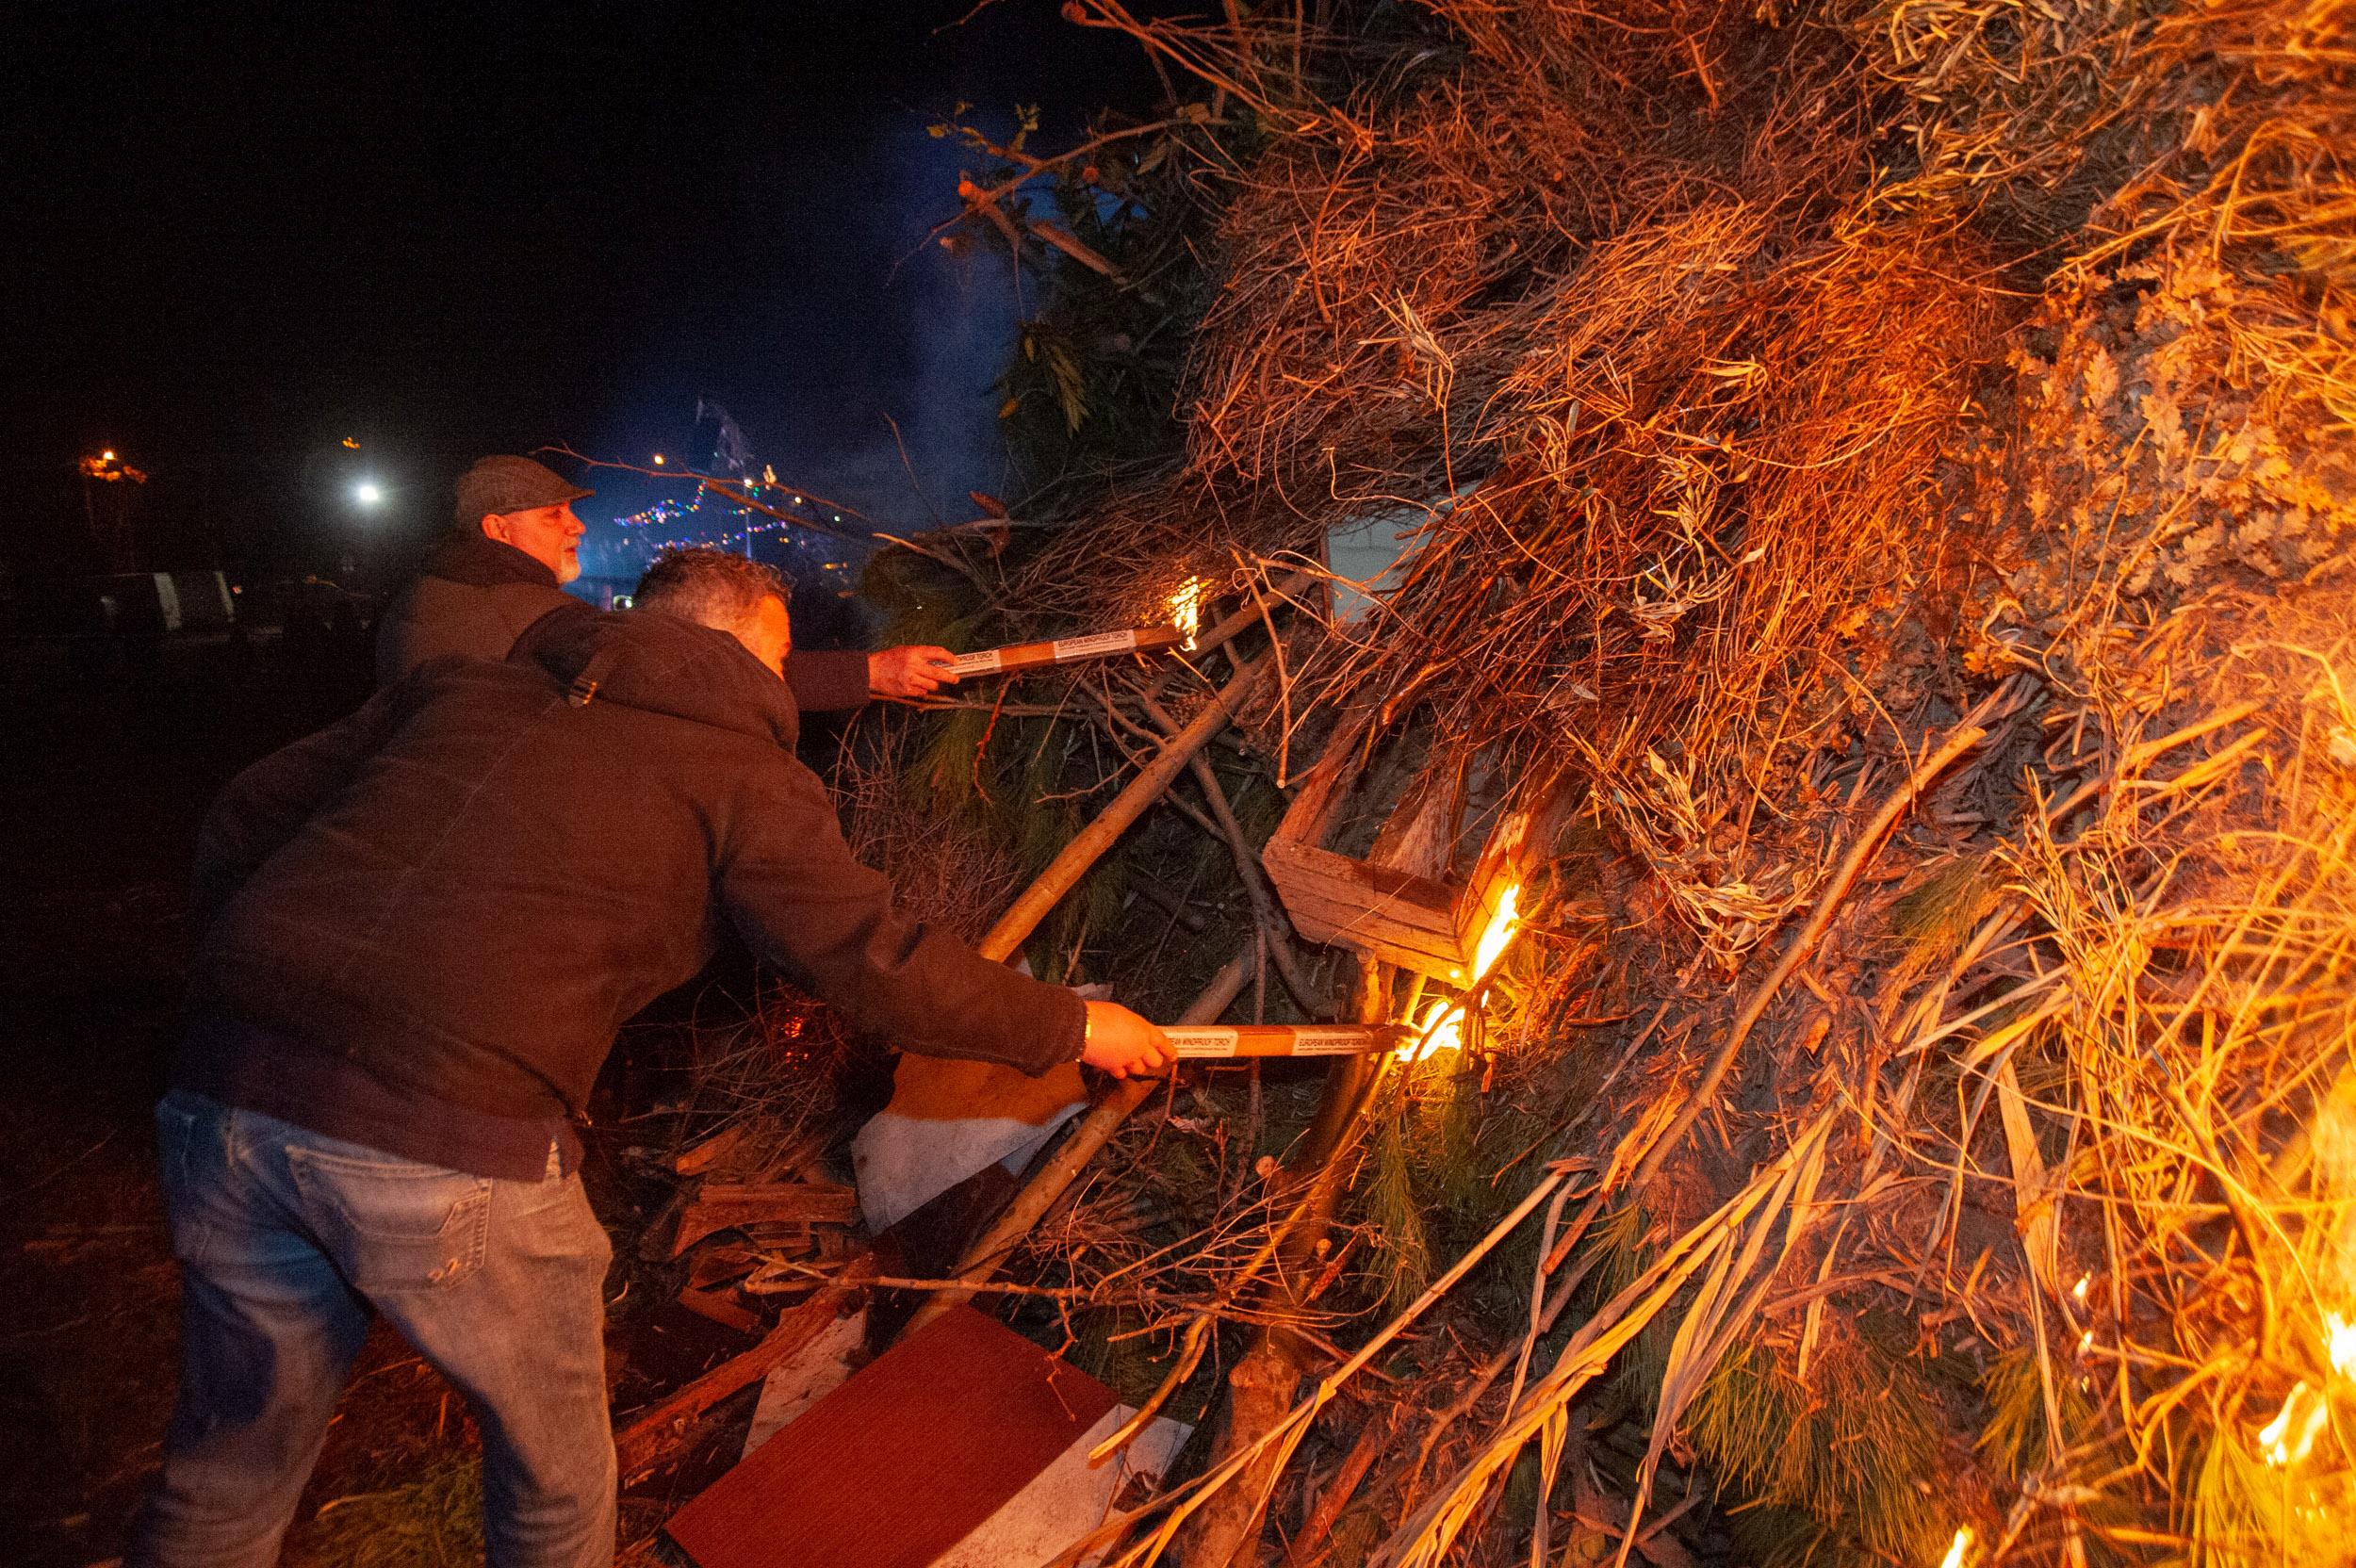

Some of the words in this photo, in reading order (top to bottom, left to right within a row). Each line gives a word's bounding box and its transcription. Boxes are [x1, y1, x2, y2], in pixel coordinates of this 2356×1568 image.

[1058, 639, 1083, 648] EUROPEAN
[1111, 631, 1127, 640] TORCH
[1214, 1037, 1230, 1046] TORCH
